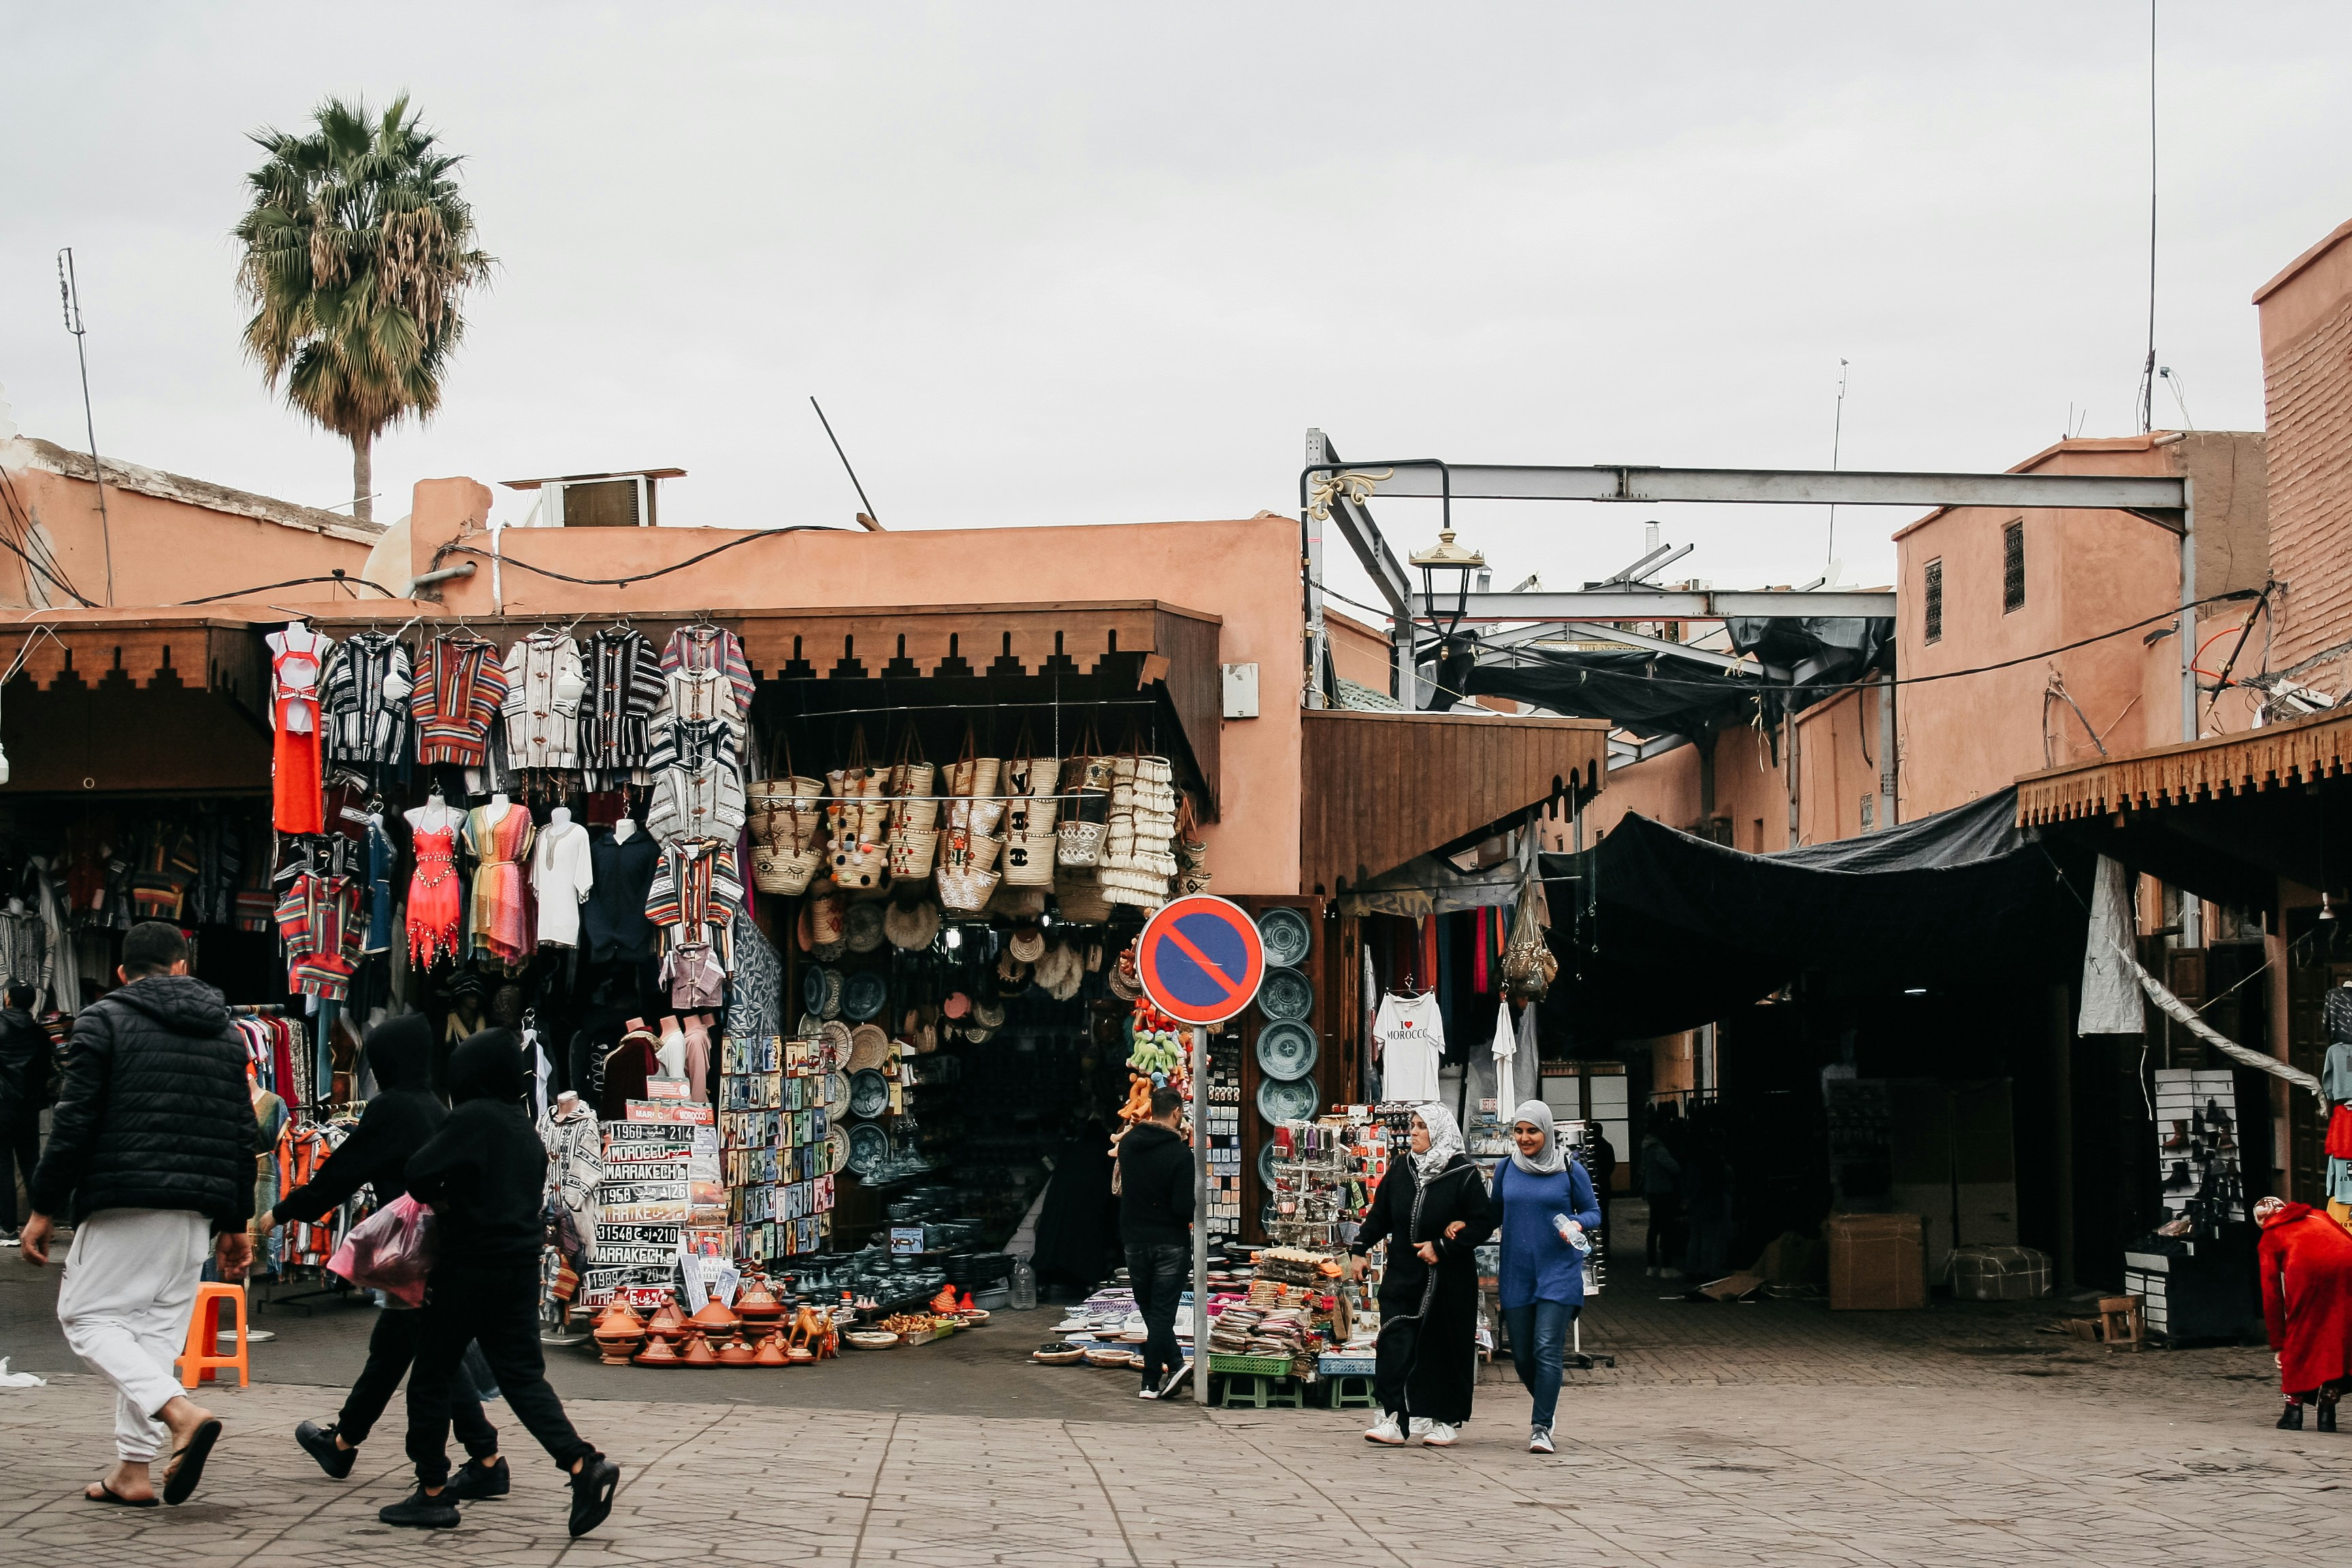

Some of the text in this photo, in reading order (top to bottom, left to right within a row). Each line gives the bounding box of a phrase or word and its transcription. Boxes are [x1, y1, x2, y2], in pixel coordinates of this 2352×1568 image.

[636, 1110, 664, 1120] MARC
[679, 1111, 706, 1121] MOROCCO
[617, 1125, 642, 1139] 1960
[611, 1144, 666, 1161] MOROCCO
[606, 1164, 676, 1180] MARRAKECH
[603, 1188, 632, 1203] 1958
[599, 1226, 632, 1240] 31548
[593, 1271, 618, 1287] 1989
